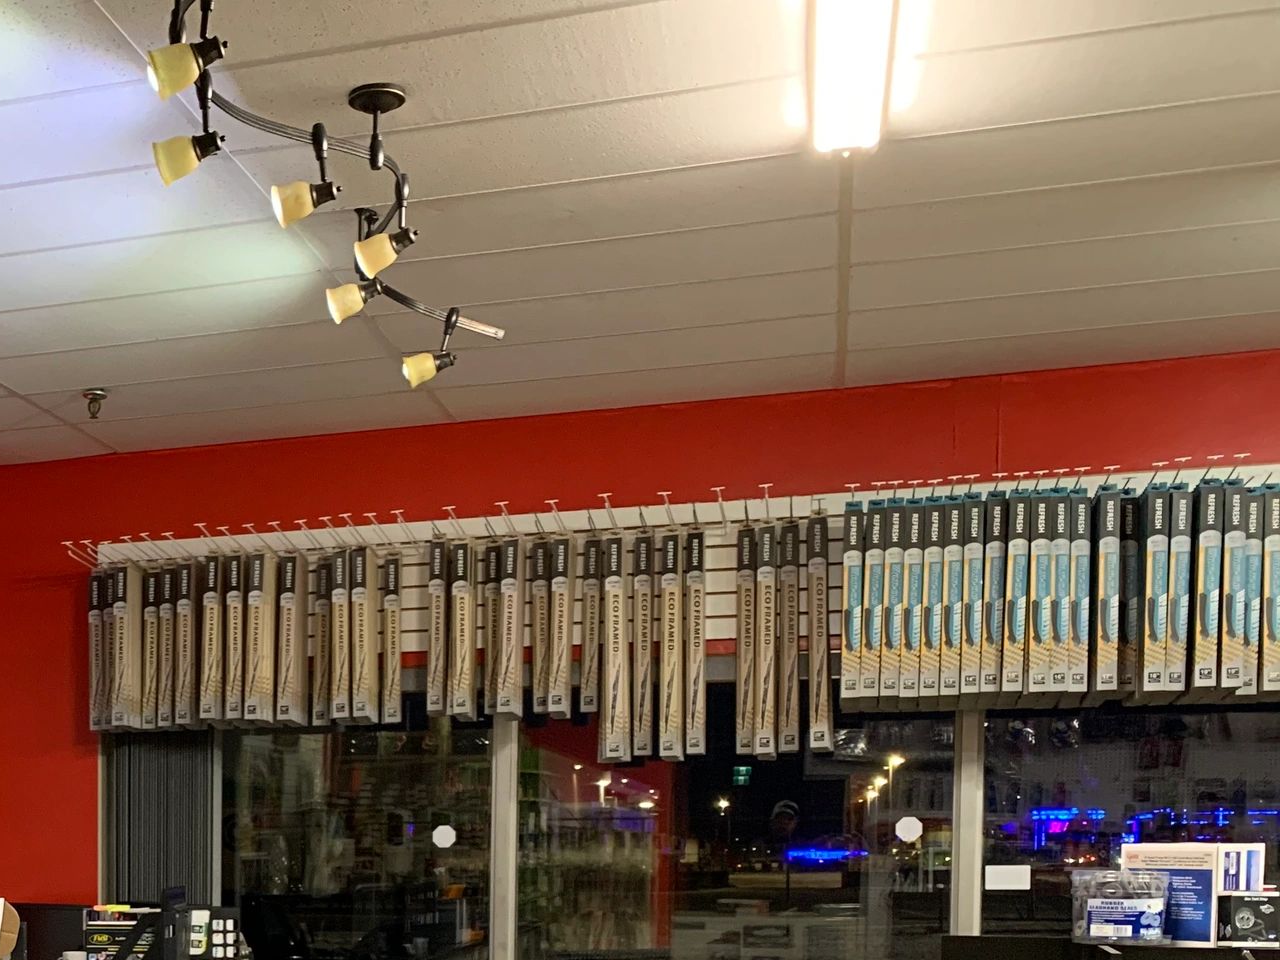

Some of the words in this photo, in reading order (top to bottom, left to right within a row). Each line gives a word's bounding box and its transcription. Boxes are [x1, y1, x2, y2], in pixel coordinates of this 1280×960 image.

[971, 507, 979, 537] REFRESH
[1016, 503, 1024, 533] REFRESH
[1155, 498, 1163, 529] REFRESH
[1179, 499, 1187, 530] REFRESH
[1208, 493, 1216, 525] REFRESH
[1232, 494, 1241, 525] REFRESH
[1249, 502, 1257, 533] REFRESH
